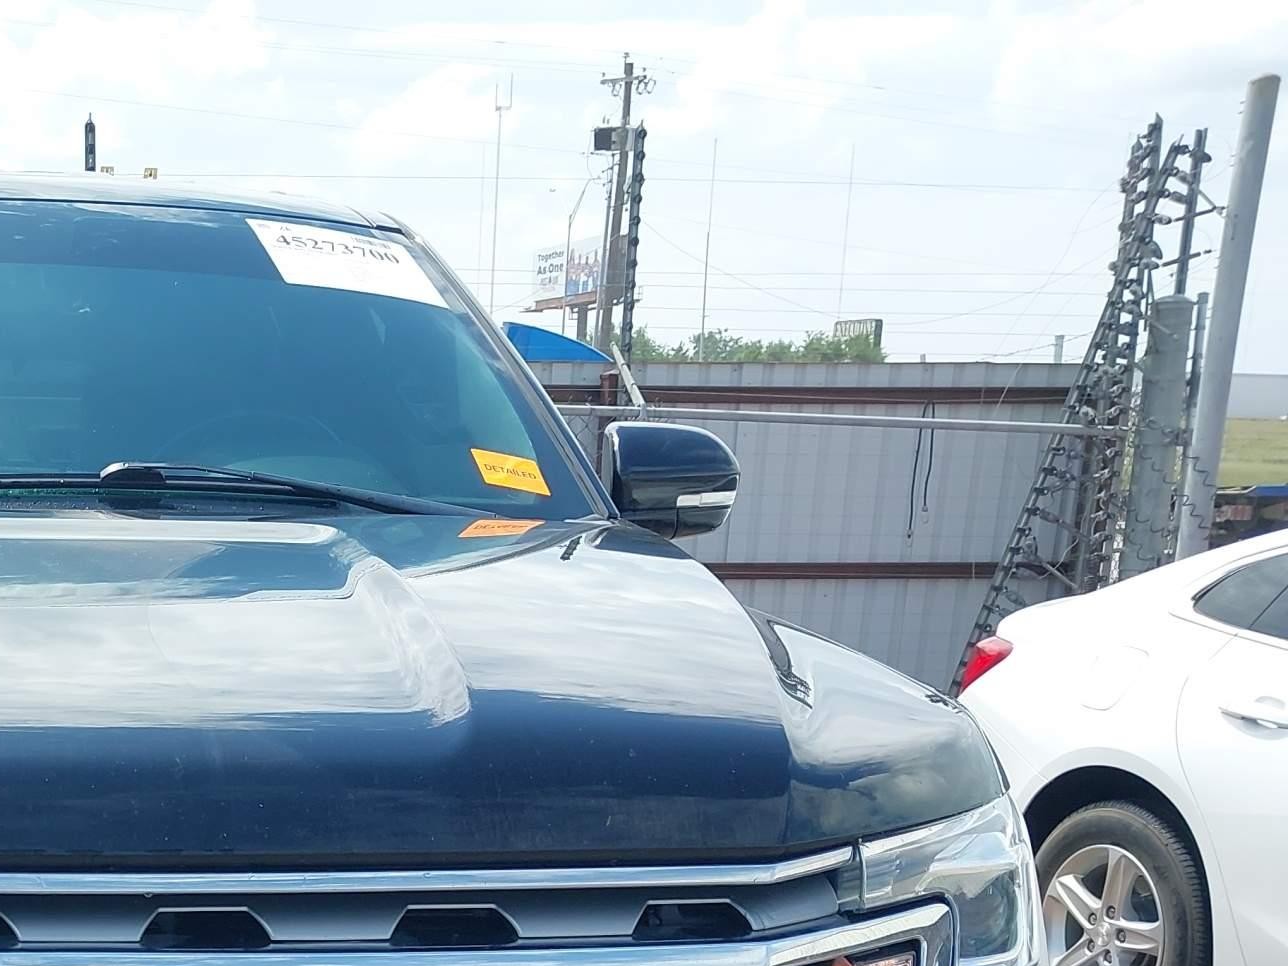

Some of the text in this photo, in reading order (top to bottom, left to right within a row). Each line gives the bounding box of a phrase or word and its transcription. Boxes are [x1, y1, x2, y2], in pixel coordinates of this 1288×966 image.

[276, 234, 400, 264] 45273700
[537, 250, 564, 263] Together
[537, 263, 564, 275] As One
